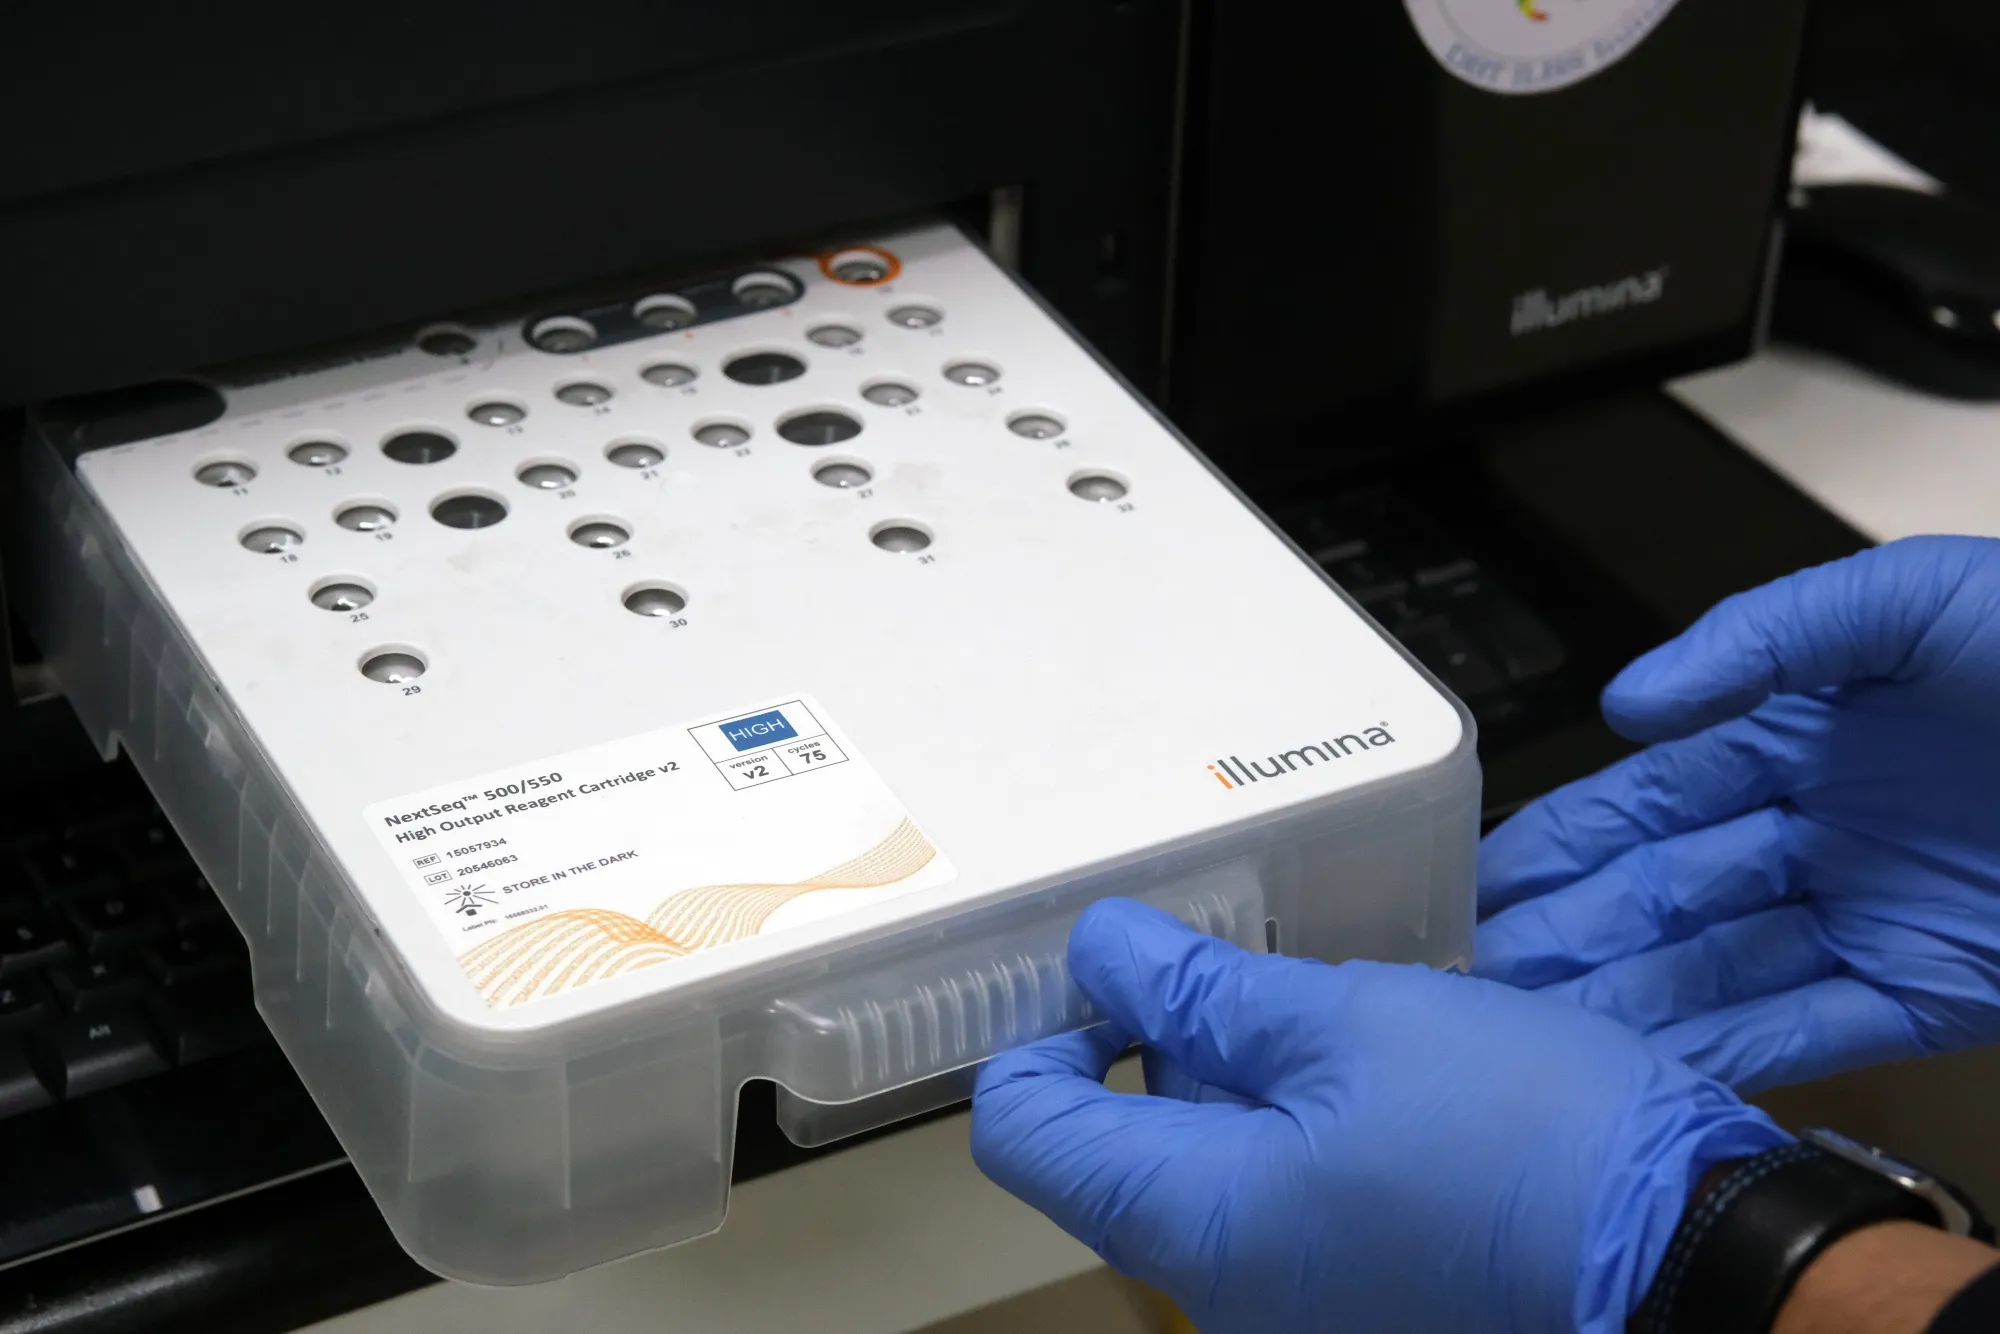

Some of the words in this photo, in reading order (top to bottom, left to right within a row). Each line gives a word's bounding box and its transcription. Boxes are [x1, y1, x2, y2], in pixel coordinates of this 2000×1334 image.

[350, 612, 369, 623] 25
[669, 617, 688, 629] 30
[402, 685, 421, 697] 29
[728, 718, 785, 741] HIGH
[787, 740, 821, 755] cycles
[729, 754, 768, 770] version
[799, 750, 827, 765] 75
[743, 765, 769, 780] v2
[483, 771, 563, 802] 500/550
[395, 825, 437, 845] High
[439, 808, 503, 833] Output
[505, 788, 577, 816] Reagent
[579, 768, 656, 795] Cartridge
[658, 760, 681, 774] v2
[416, 854, 438, 868] REF
[446, 837, 507, 860] 15057934
[428, 872, 449, 885] LOT
[456, 853, 518, 877] 20546063
[502, 875, 550, 895] STORE
[551, 869, 567, 882] IN
[568, 862, 598, 877] THE
[598, 849, 639, 870] DARK
